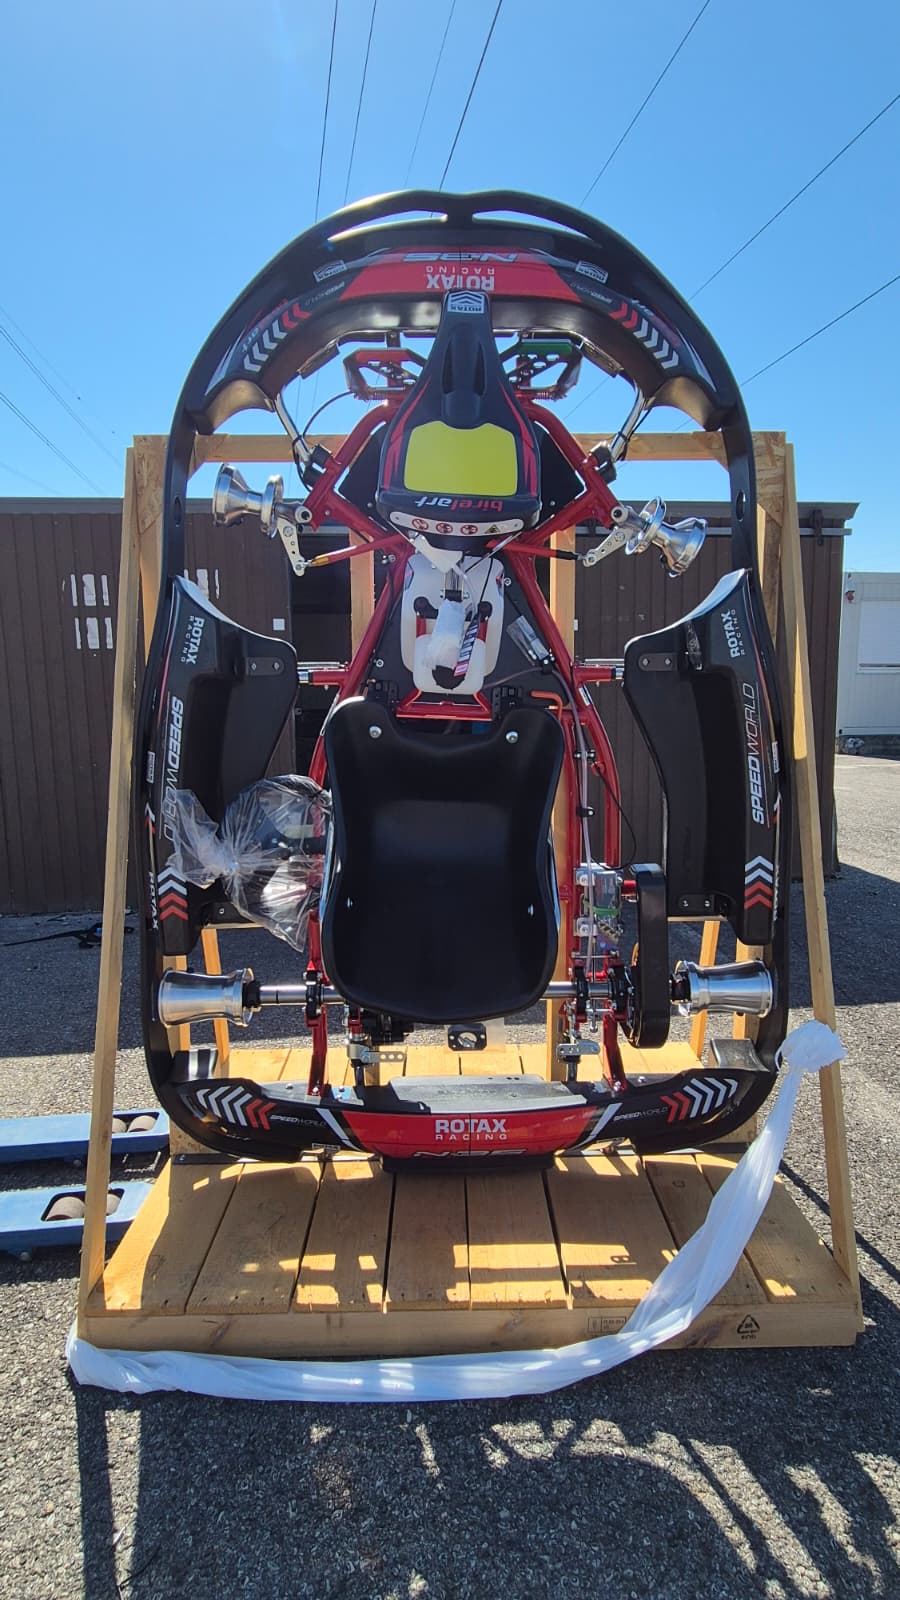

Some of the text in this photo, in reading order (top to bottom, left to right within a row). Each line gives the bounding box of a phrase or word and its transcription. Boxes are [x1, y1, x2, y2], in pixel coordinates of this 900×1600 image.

[425, 265, 495, 275] RACING
[426, 273, 495, 291] ROTAX
[414, 496, 504, 513] birelart
[180, 615, 195, 663] RACING
[186, 616, 205, 664] ROTAX
[720, 610, 741, 659] ROTAX
[730, 608, 746, 656] RACING
[163, 696, 184, 842] SPEEDWORLD
[743, 682, 765, 825] SPEEDWORLD
[435, 1119, 507, 1133] ROTAX
[435, 1133, 508, 1141] RACING
